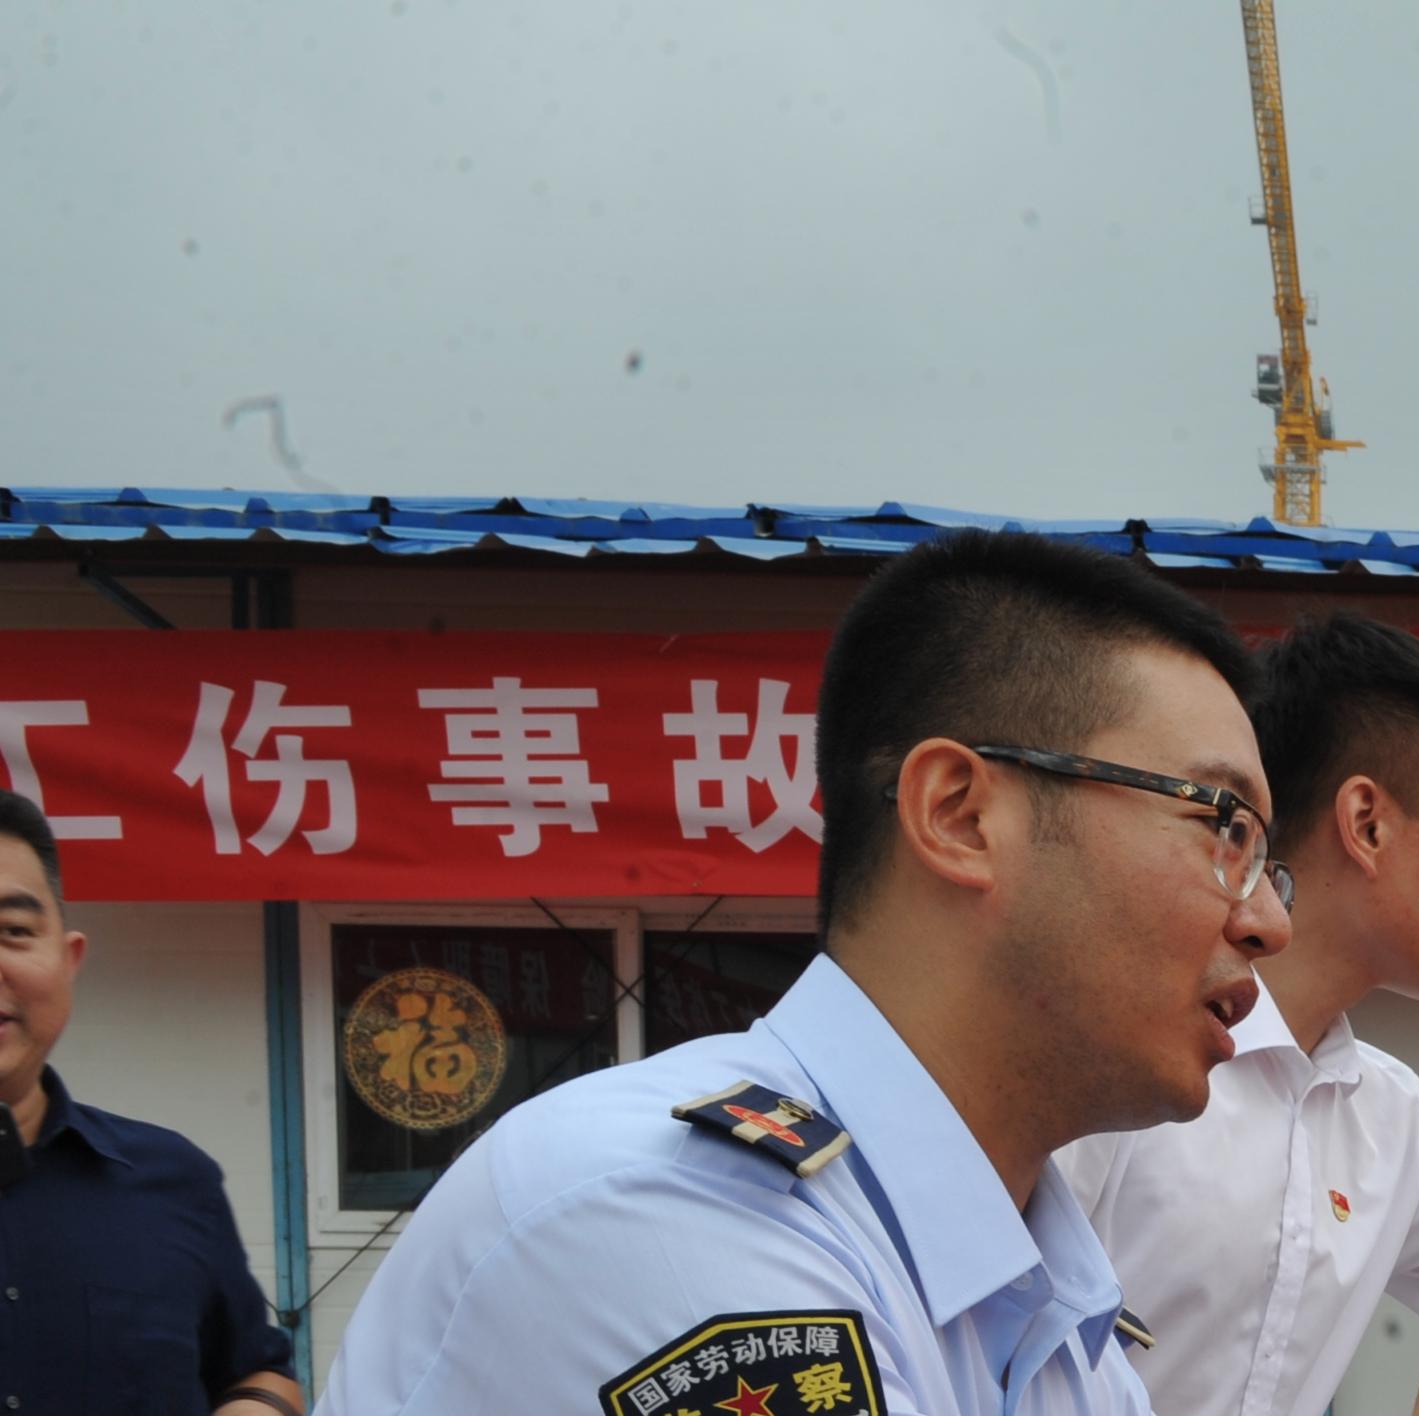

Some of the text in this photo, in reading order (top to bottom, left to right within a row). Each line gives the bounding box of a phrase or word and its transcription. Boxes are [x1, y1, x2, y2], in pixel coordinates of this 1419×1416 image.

[627, 1326, 840, 1416] 国家劳动保障
